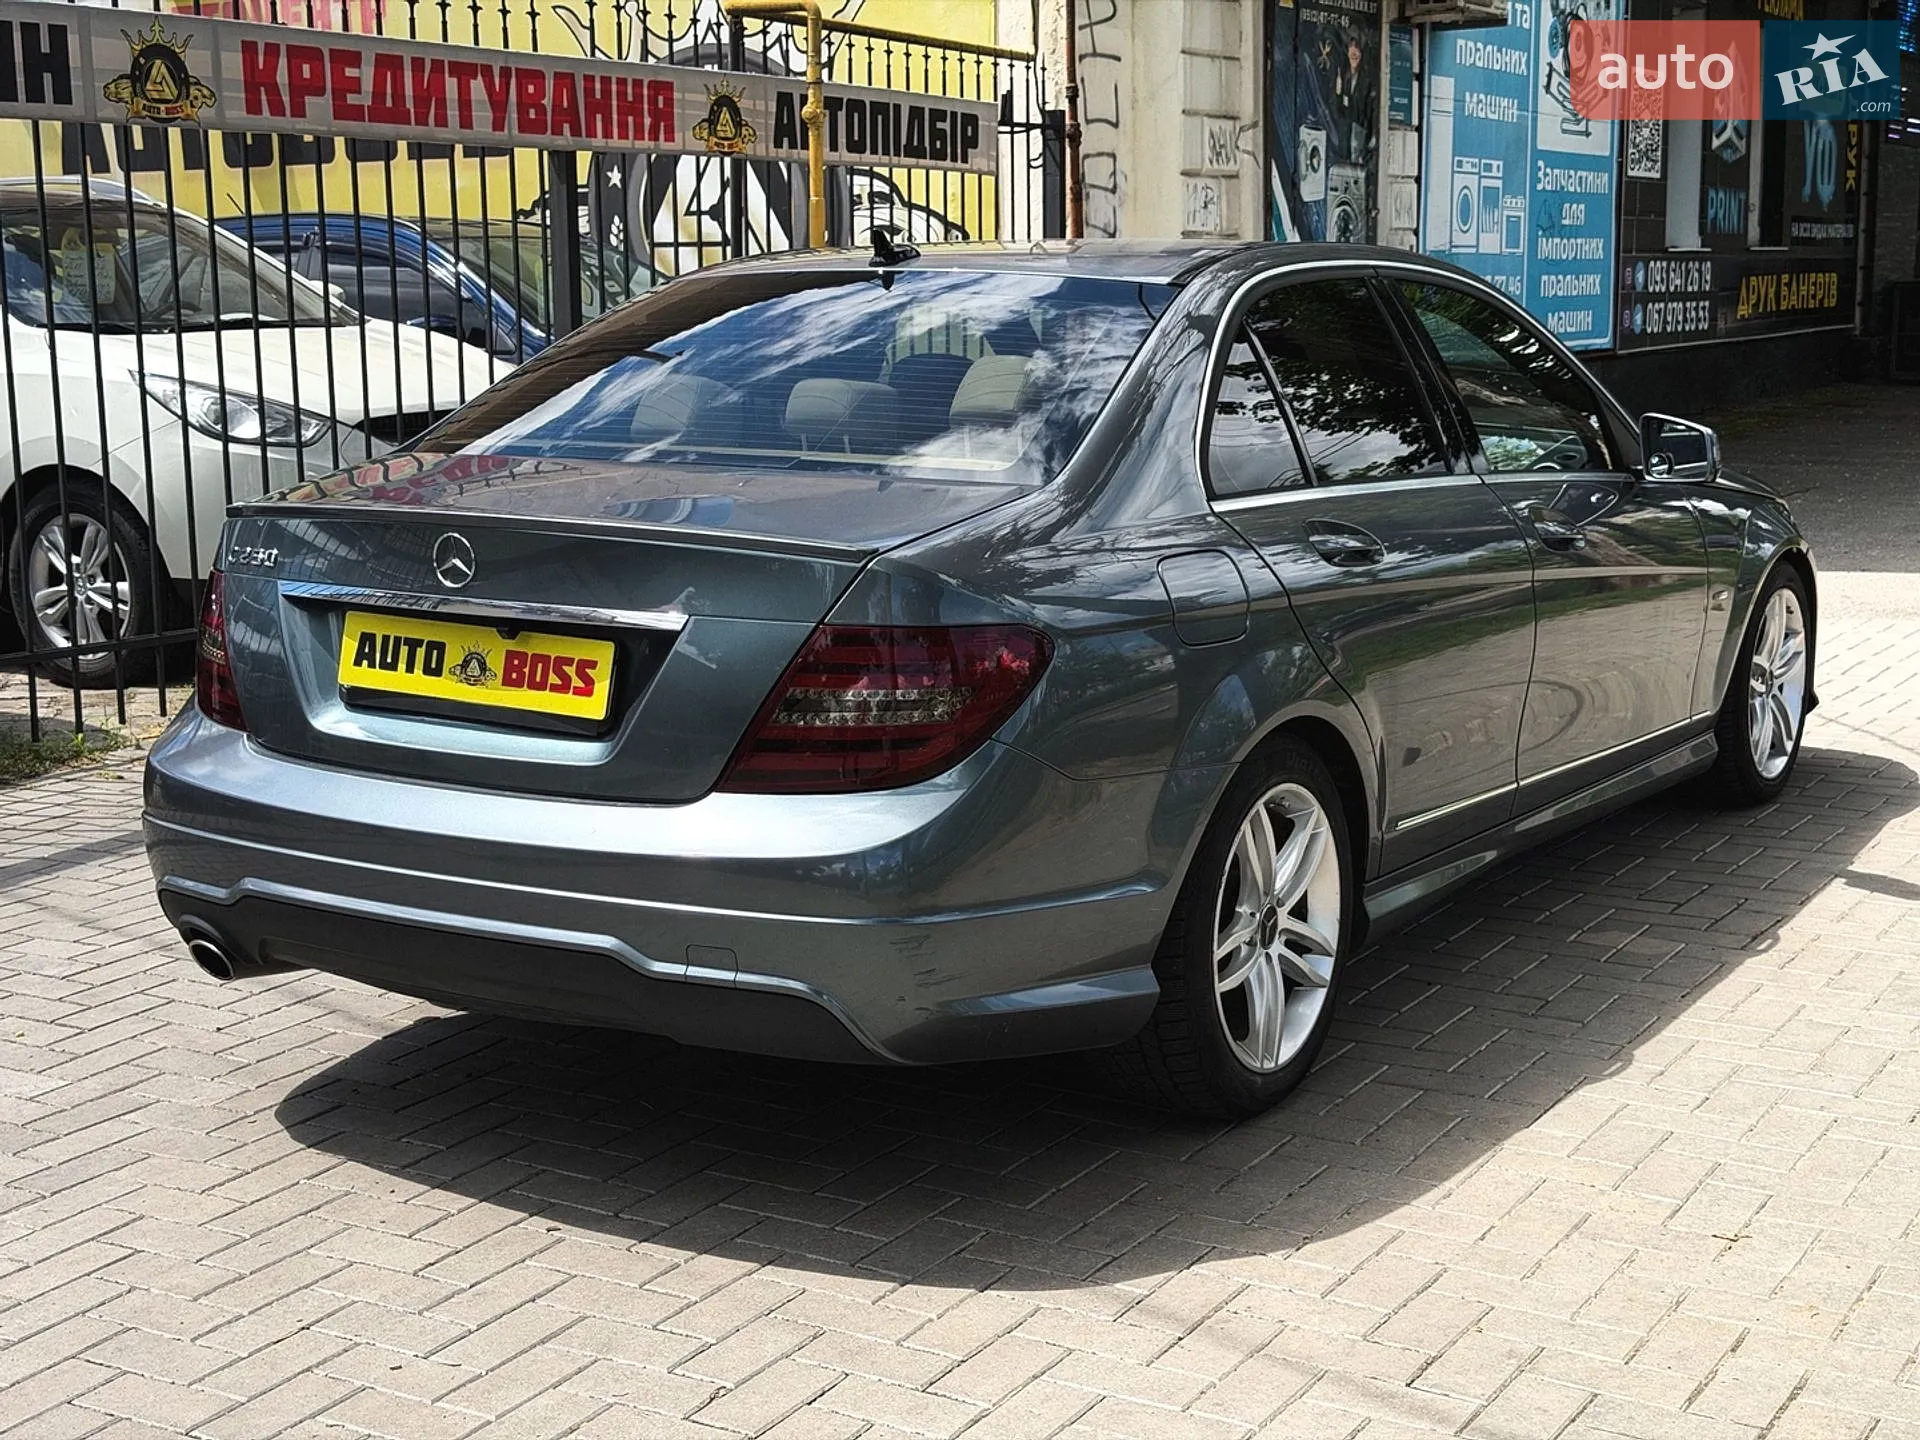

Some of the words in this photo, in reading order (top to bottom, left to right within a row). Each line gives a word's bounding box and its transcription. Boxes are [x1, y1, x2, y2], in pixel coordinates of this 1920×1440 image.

[1455, 39, 1528, 76] пральних
[241, 40, 676, 143] КРЕДИТУВАННЯ
[1464, 91, 1518, 122] машин
[1535, 160, 1609, 194] Запчастини
[1561, 204, 1585, 227] для
[1706, 186, 1747, 234] PRINT
[1537, 231, 1604, 260] імпортних
[1540, 273, 1601, 298] пральних
[1647, 261, 1667, 292] 093
[1668, 261, 1686, 291] 641
[1687, 262, 1699, 291] 26
[1700, 261, 1712, 291] 19
[1736, 275, 1776, 320] ДРУК
[1780, 272, 1838, 310] БАНЕРІВ
[1547, 309, 1592, 334] машин
[1646, 302, 1664, 332] 067
[1665, 302, 1683, 331] 979
[1685, 302, 1697, 331] 35
[1698, 301, 1709, 330] 53
[353, 631, 447, 678] AUTO
[501, 649, 598, 697] BOSS
